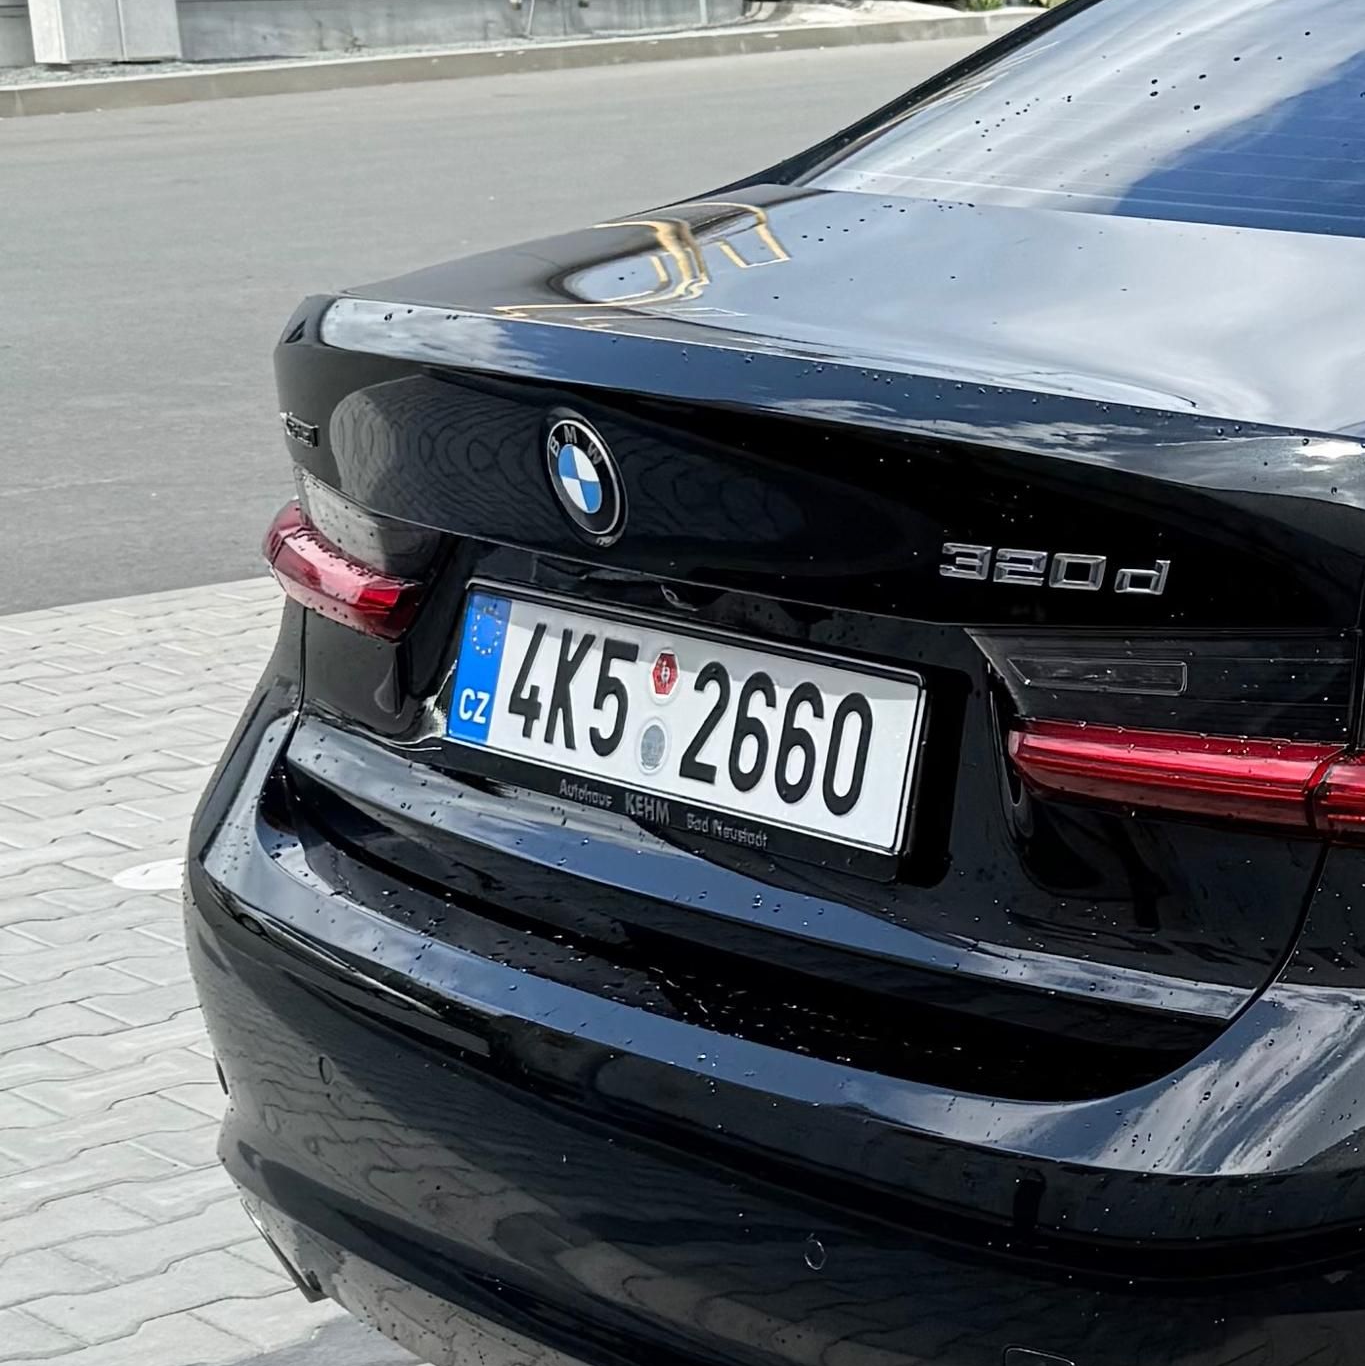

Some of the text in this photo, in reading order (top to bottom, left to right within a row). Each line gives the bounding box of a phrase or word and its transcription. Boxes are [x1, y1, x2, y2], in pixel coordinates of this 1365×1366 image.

[550, 424, 603, 466] BMW
[458, 687, 491, 724] CZ
[508, 621, 874, 817] 4K5 2660
[559, 778, 768, 847] Autohaus KEHM Bad Neustadt
